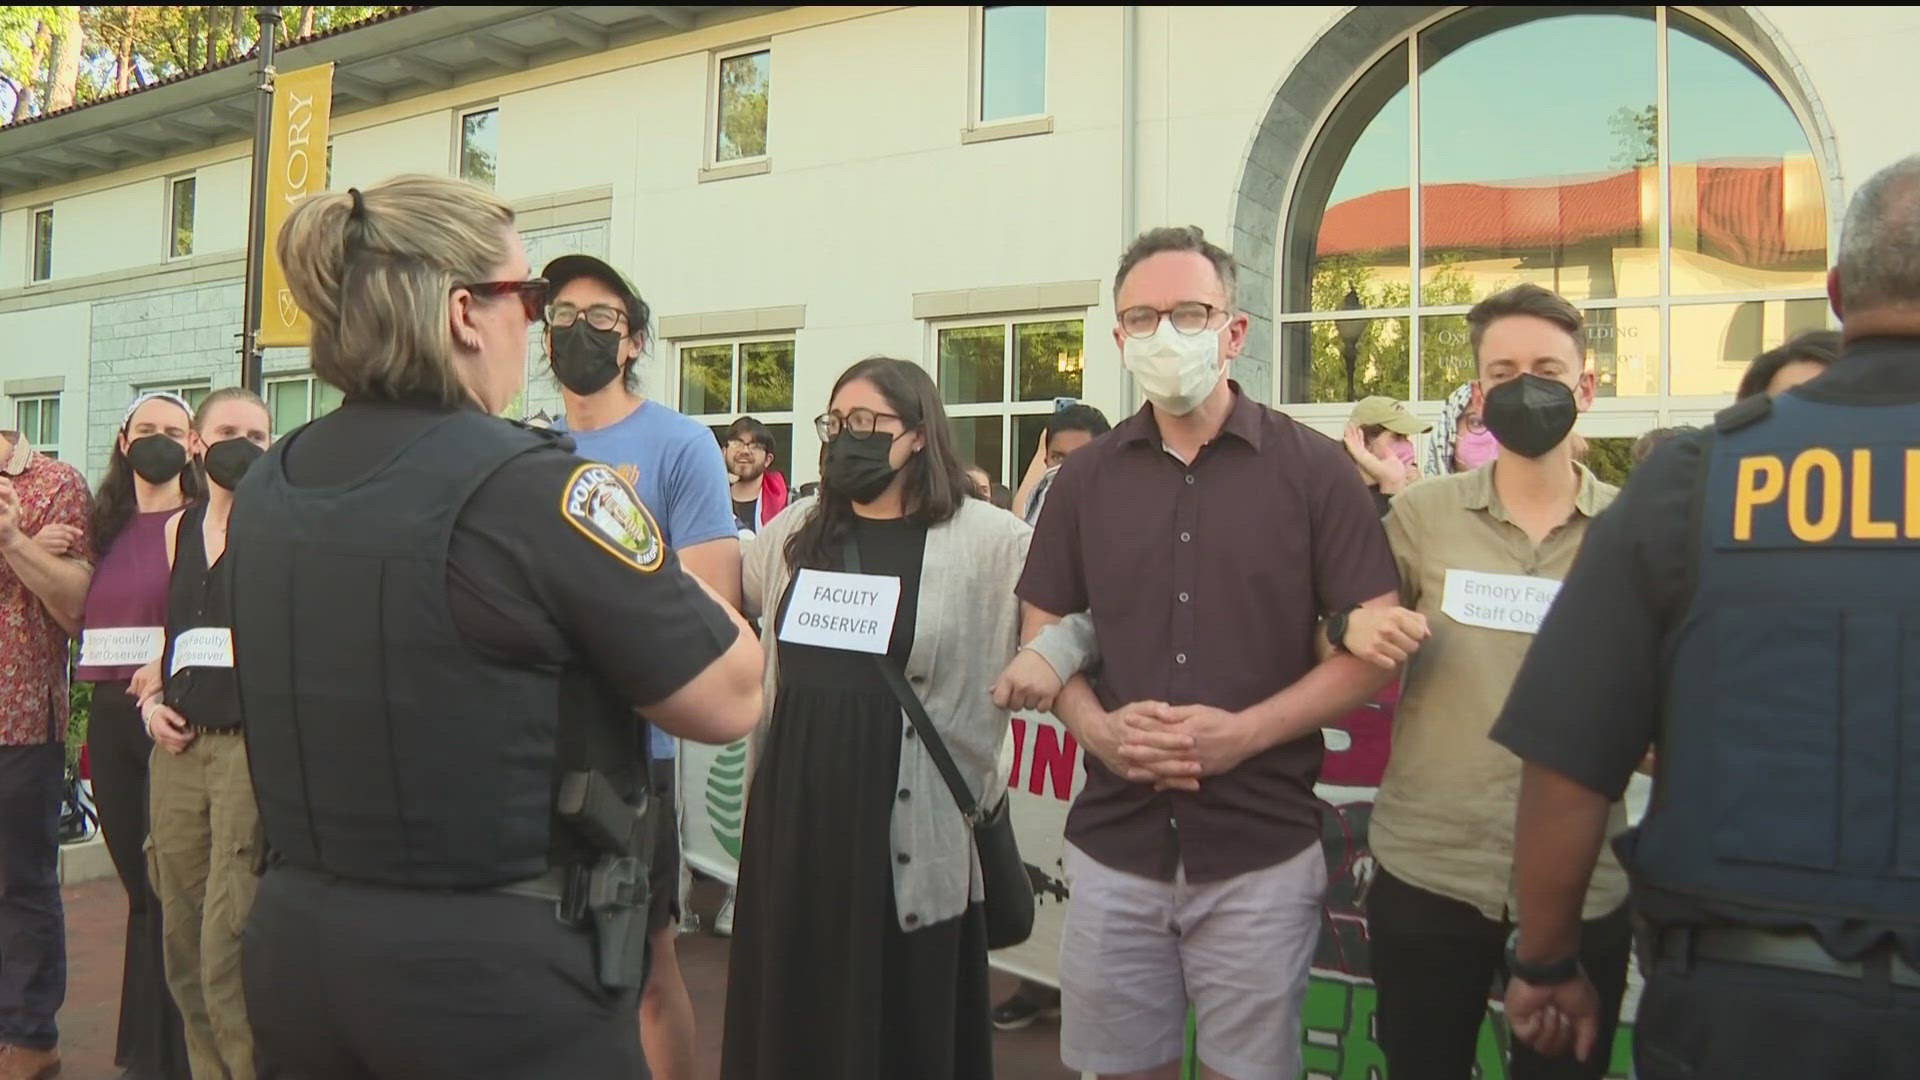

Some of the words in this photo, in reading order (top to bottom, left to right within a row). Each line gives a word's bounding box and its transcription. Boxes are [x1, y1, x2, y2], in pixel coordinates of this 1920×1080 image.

[1588, 327, 1638, 339] LDING
[1733, 447, 1920, 542] POLI
[813, 586, 879, 606] FACULTY
[1464, 579, 1520, 604] Emory
[1524, 586, 1556, 604] Fac
[797, 611, 878, 636] OBSERVER
[1463, 602, 1506, 621] Staff
[1509, 608, 1543, 625] Obs
